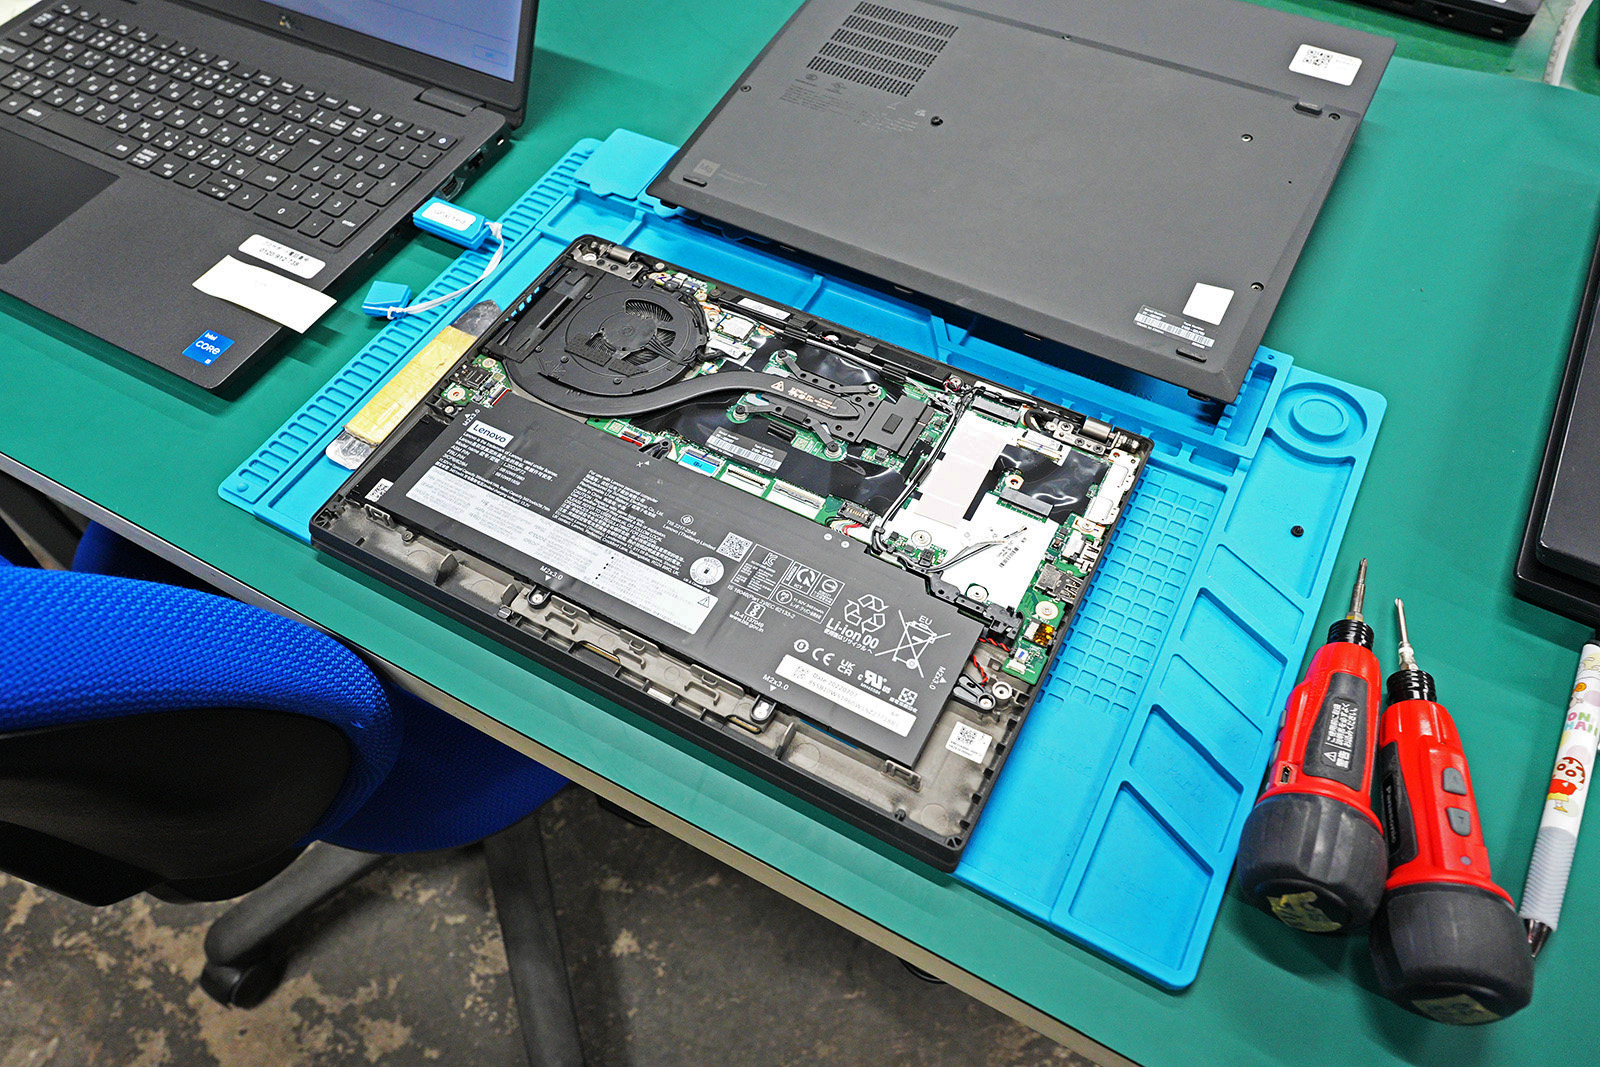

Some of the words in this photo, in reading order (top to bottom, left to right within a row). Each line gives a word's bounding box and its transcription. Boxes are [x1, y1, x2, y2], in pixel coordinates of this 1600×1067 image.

[205, 333, 218, 341] intel
[195, 341, 220, 355] CORE
[471, 423, 508, 443] Lenovo
[539, 564, 564, 581] M2x3.0
[918, 614, 932, 626] EU
[826, 618, 862, 643] Li-ion
[861, 634, 880, 650] 00
[762, 674, 790, 691] M2x3.0
[928, 666, 946, 690] M2x3.0
